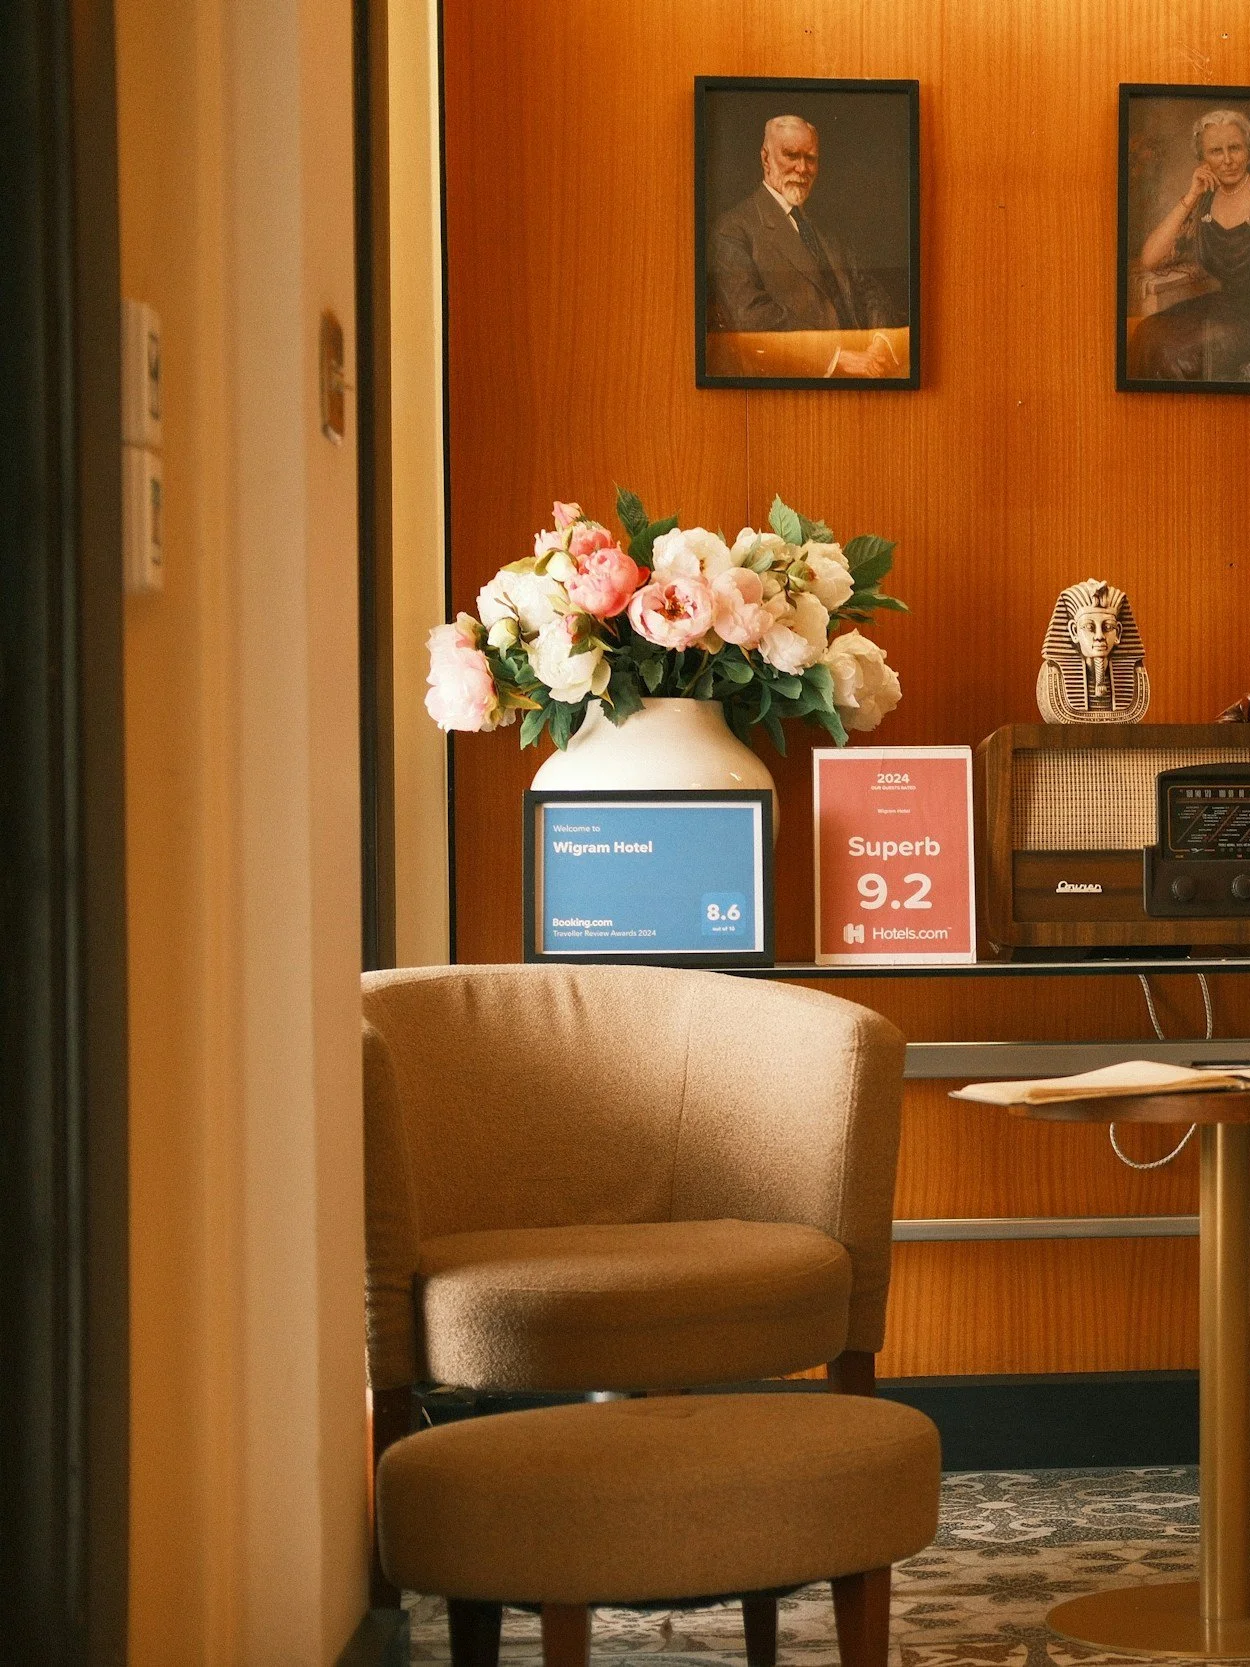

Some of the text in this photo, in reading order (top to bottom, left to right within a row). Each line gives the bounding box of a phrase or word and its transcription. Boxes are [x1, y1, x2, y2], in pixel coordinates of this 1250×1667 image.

[877, 773, 911, 784] 2024
[552, 824, 601, 833] Welcome to
[552, 840, 653, 857] Wigram Hotel
[848, 835, 941, 861] Superb
[857, 873, 933, 910] 9.2
[707, 903, 741, 921] 8.6
[552, 917, 613, 929] Booking.com
[553, 929, 657, 937] Traveller Review Awards 2024
[872, 927, 949, 940] Hotels.com
